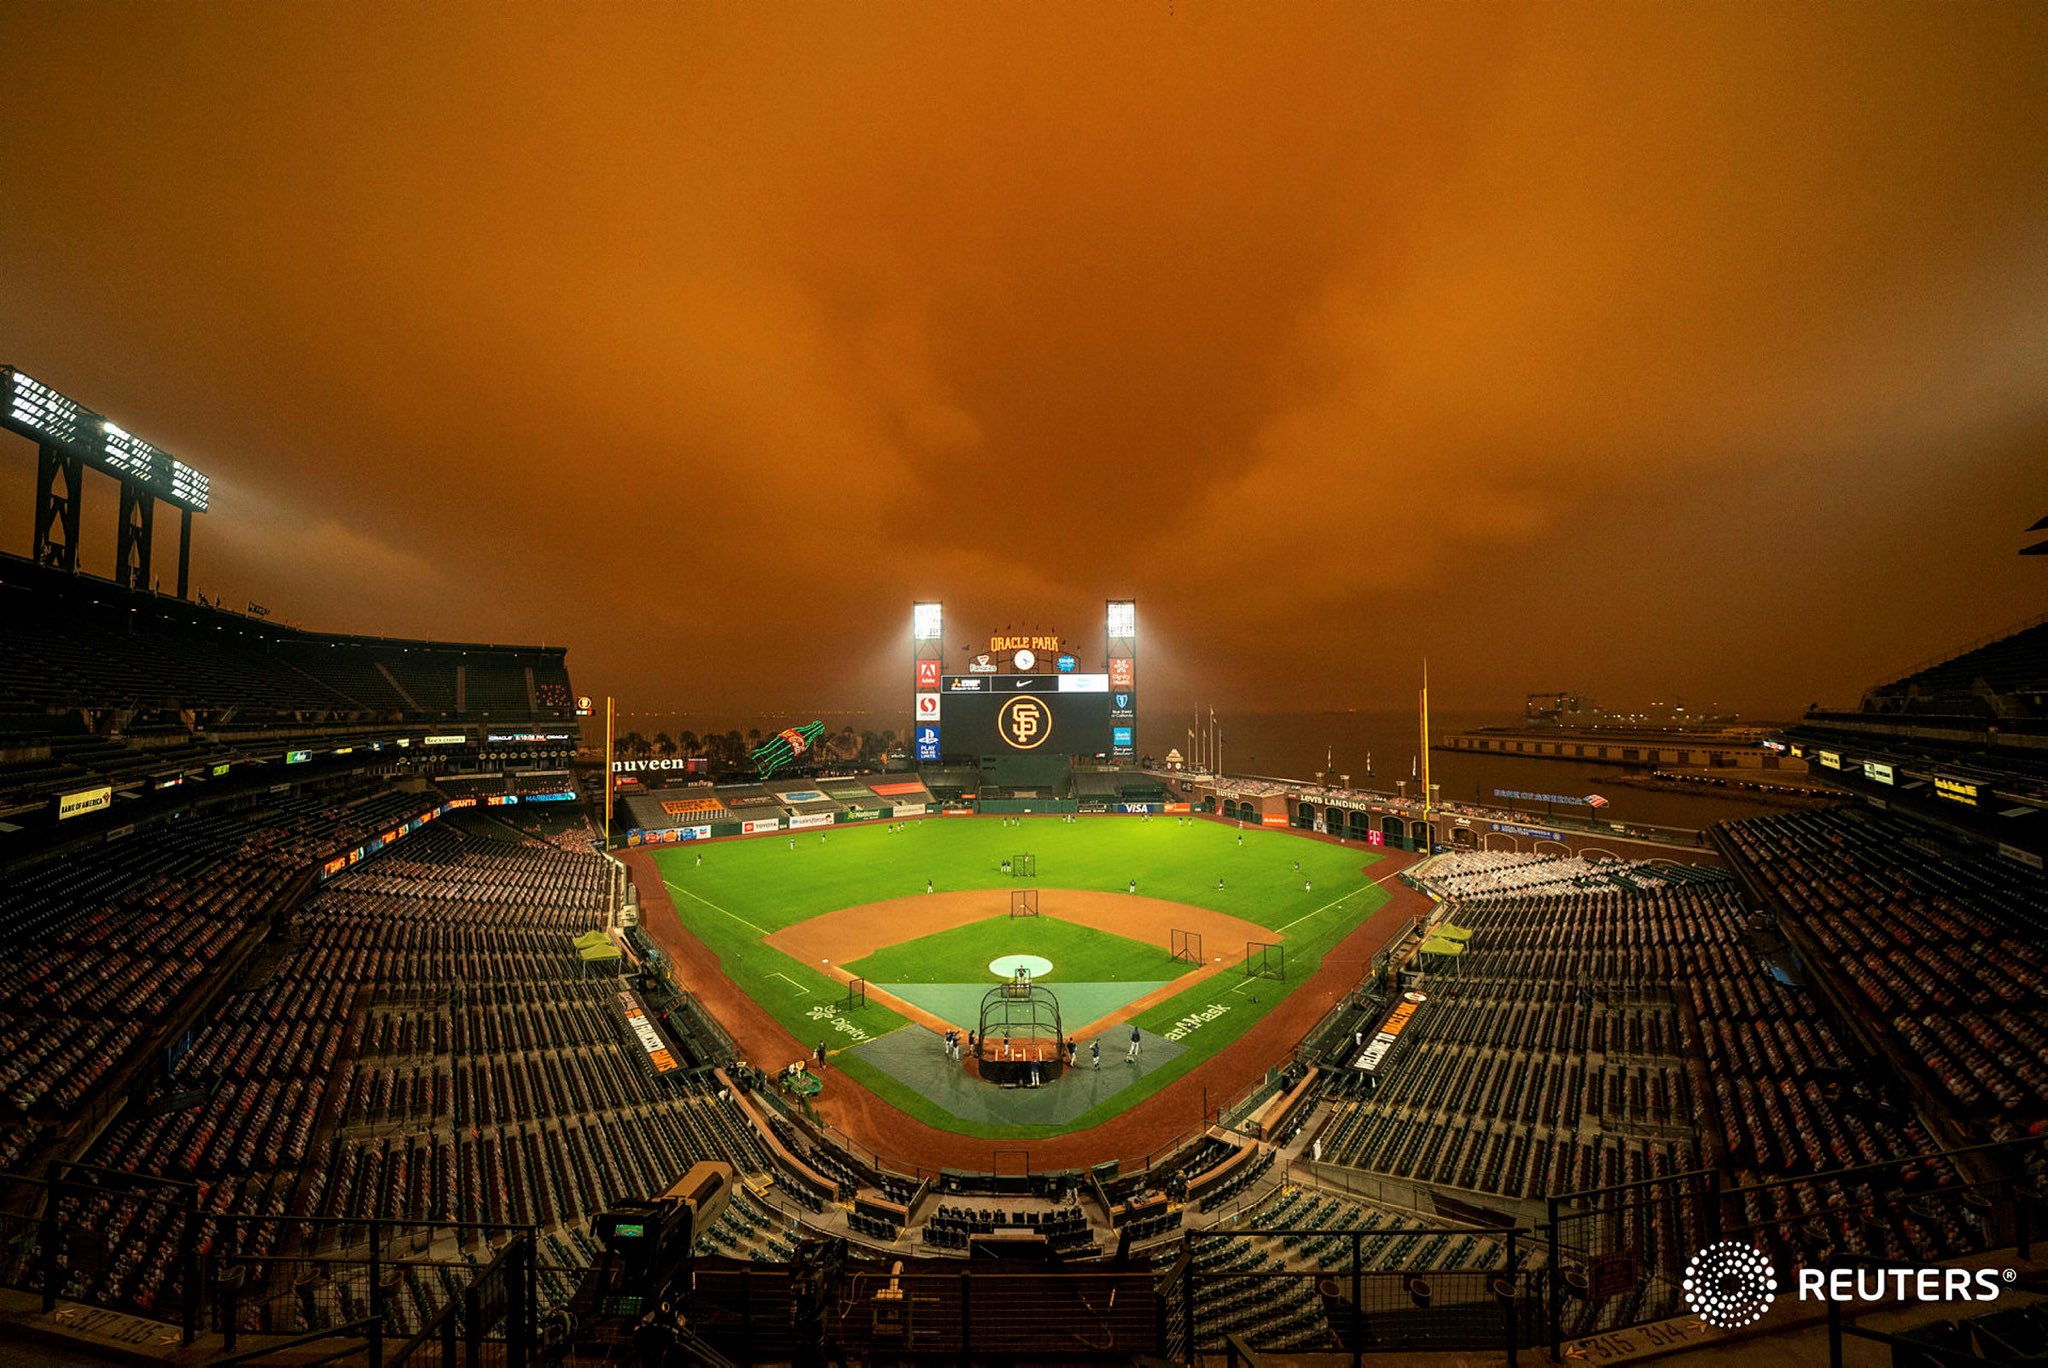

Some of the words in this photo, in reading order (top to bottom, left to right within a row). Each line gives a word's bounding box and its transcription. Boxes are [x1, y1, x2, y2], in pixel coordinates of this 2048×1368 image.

[991, 637, 1029, 652] ORACLE
[1032, 637, 1058, 652] PARK
[612, 758, 684, 772] nuveen
[61, 803, 75, 814] BANK
[81, 797, 103, 809] AMERICA
[1324, 798, 1367, 811] LANDING
[1535, 793, 1583, 805] AMERICA
[855, 809, 880, 818] National
[1125, 804, 1148, 813] VISA
[830, 1017, 869, 1041] Dignity
[1353, 1040, 1391, 1071] WELCOME
[1375, 1032, 1397, 1043] TO
[1591, 1333, 1636, 1359] 315
[1636, 1322, 1688, 1347] 314
